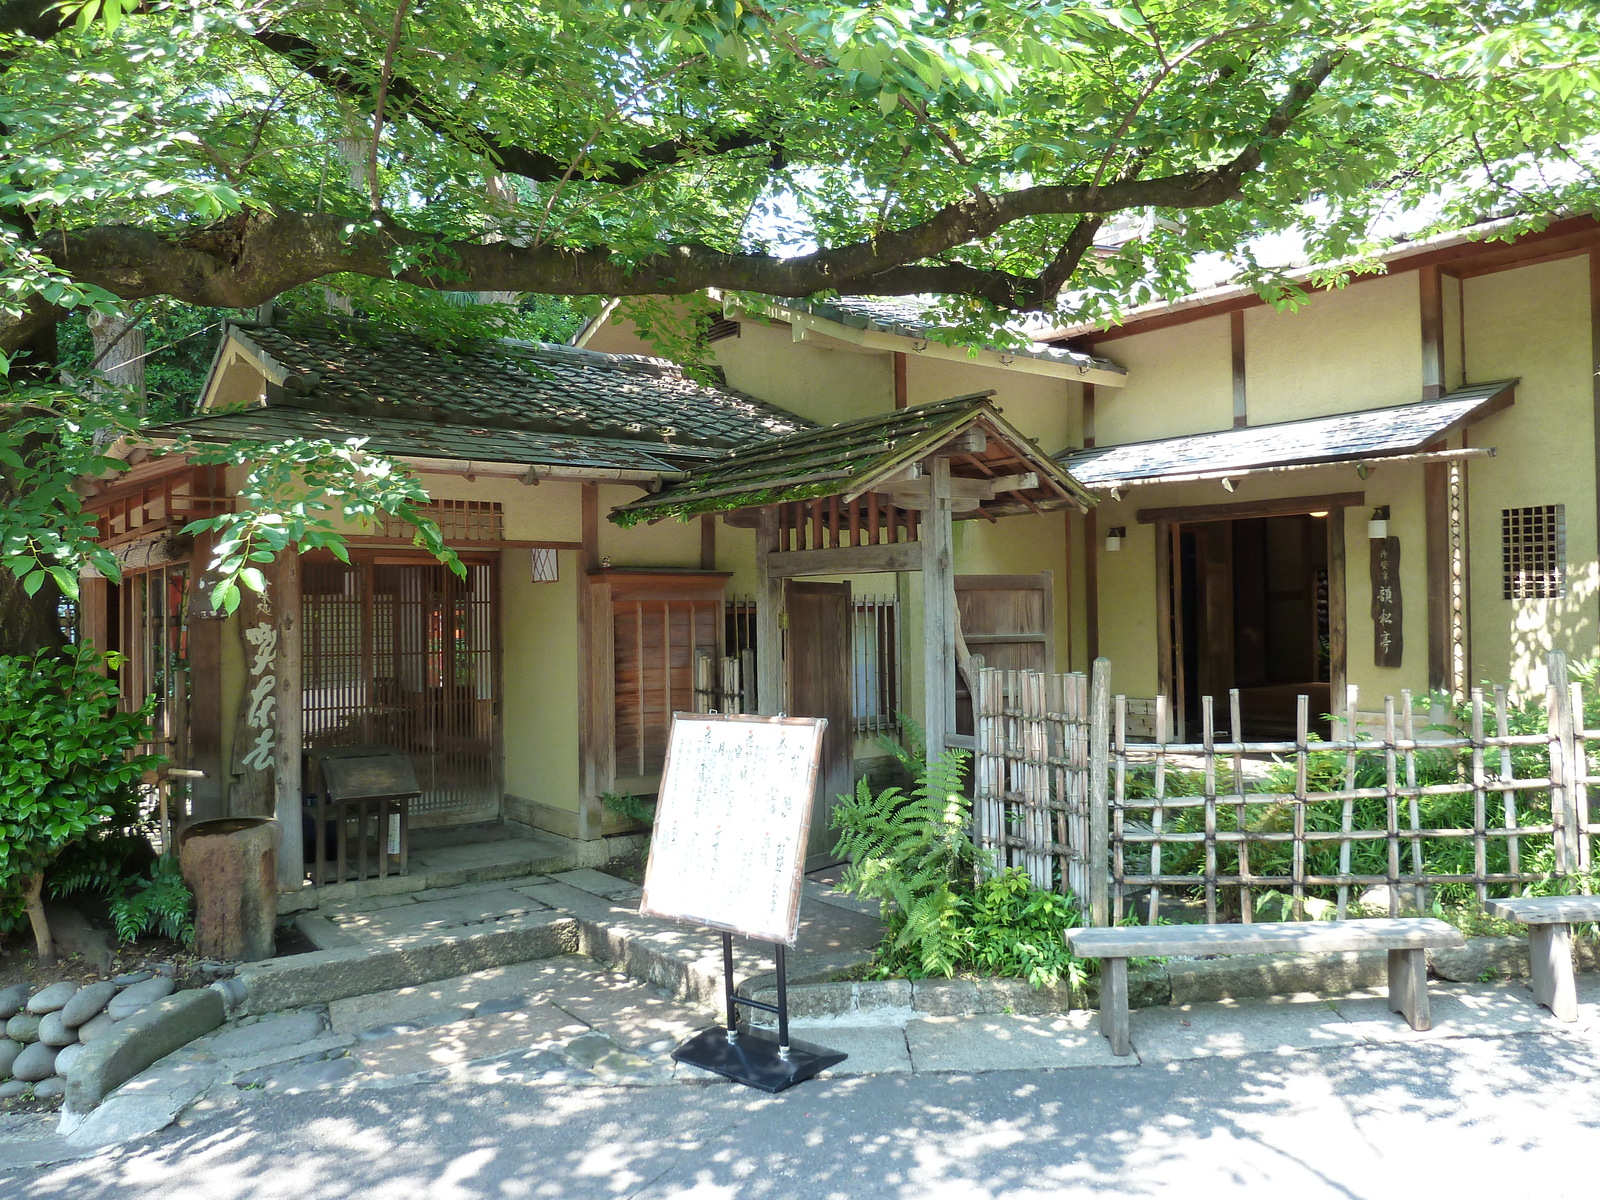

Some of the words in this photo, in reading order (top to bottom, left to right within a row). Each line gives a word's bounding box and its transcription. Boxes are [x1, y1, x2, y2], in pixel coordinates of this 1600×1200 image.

[1376, 586, 1393, 654] 韻松亭
[242, 621, 276, 771] 喫茶去
[717, 741, 725, 757] 月
